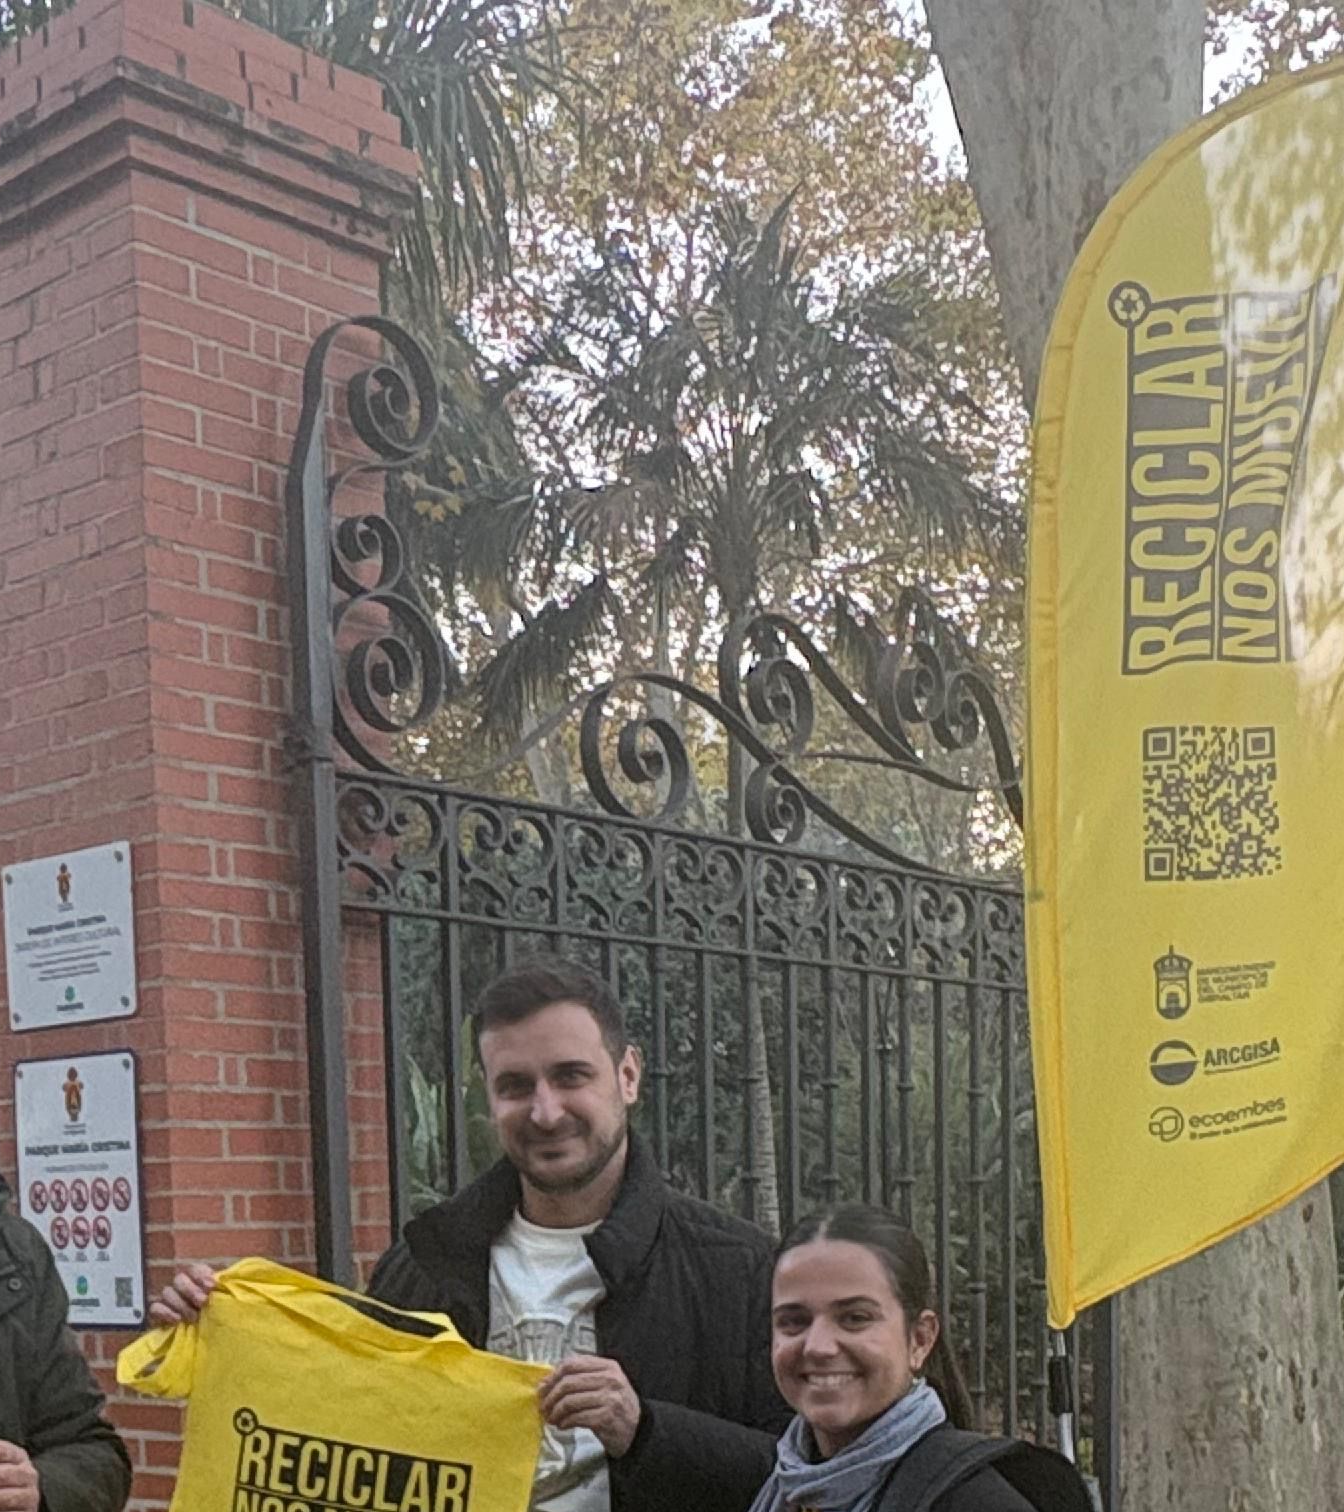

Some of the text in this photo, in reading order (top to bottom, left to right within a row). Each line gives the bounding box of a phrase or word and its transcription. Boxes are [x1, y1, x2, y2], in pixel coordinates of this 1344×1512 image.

[1130, 303, 1225, 670] RECICLAR
[1220, 526, 1280, 658] NOS
[1204, 1036, 1281, 1068] ARCGISA
[1188, 1097, 1286, 1128] ecoembes
